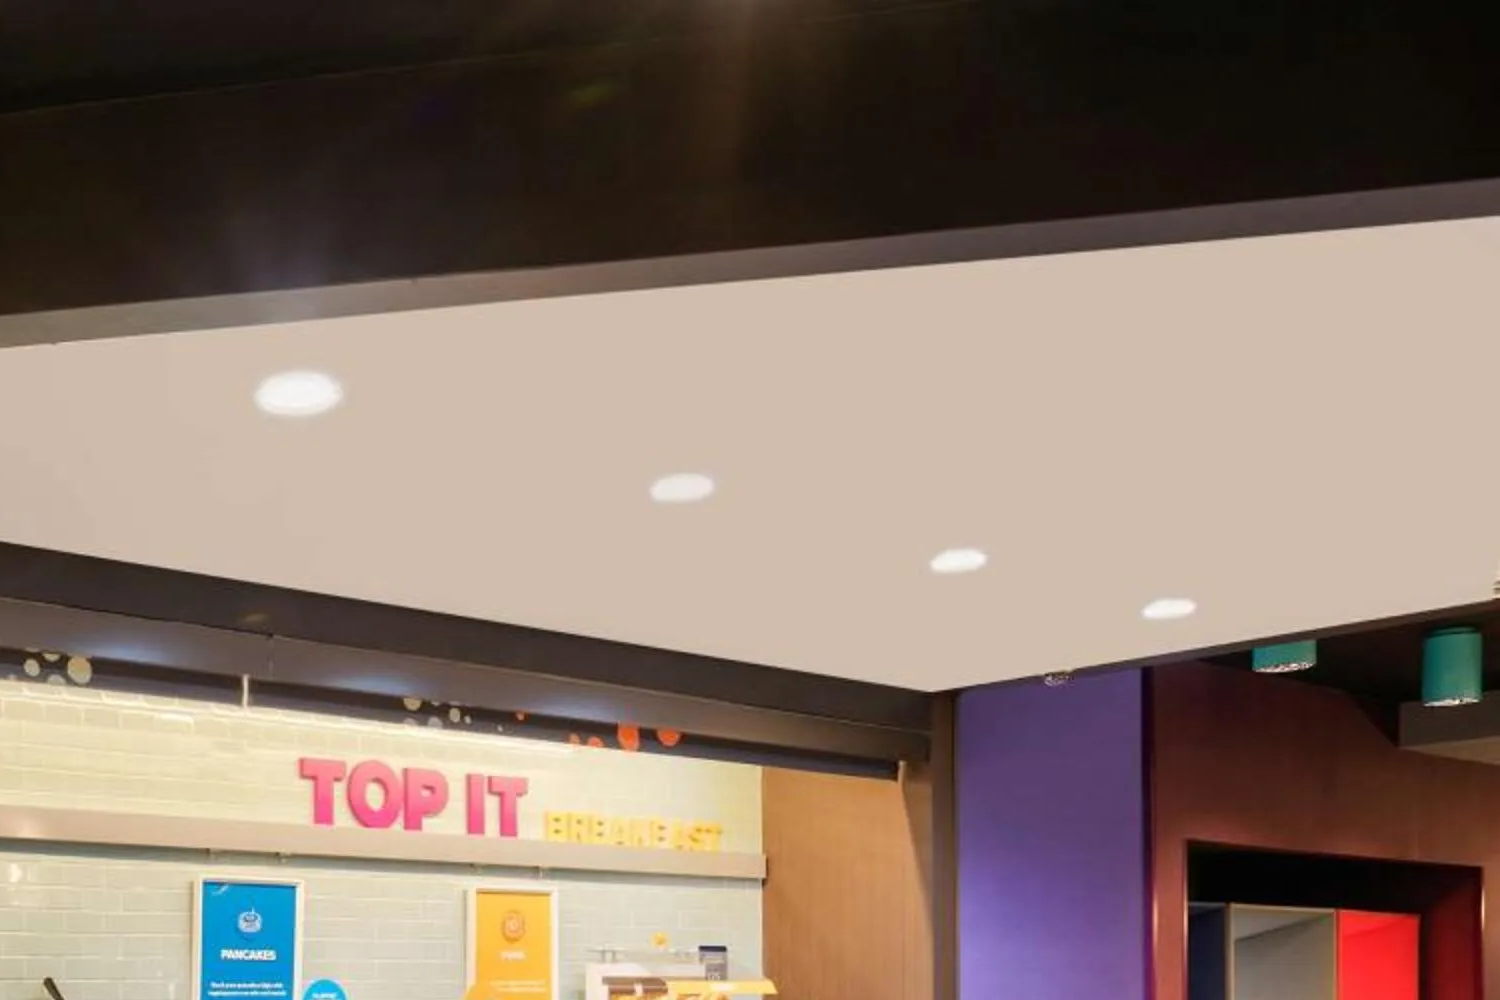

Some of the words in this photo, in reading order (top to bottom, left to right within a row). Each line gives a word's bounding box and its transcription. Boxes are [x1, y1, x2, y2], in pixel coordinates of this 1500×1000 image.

[298, 756, 449, 831] TOP
[466, 773, 529, 838] IT
[545, 811, 723, 853] BREAKFAST
[220, 949, 277, 961] PANCAKES
